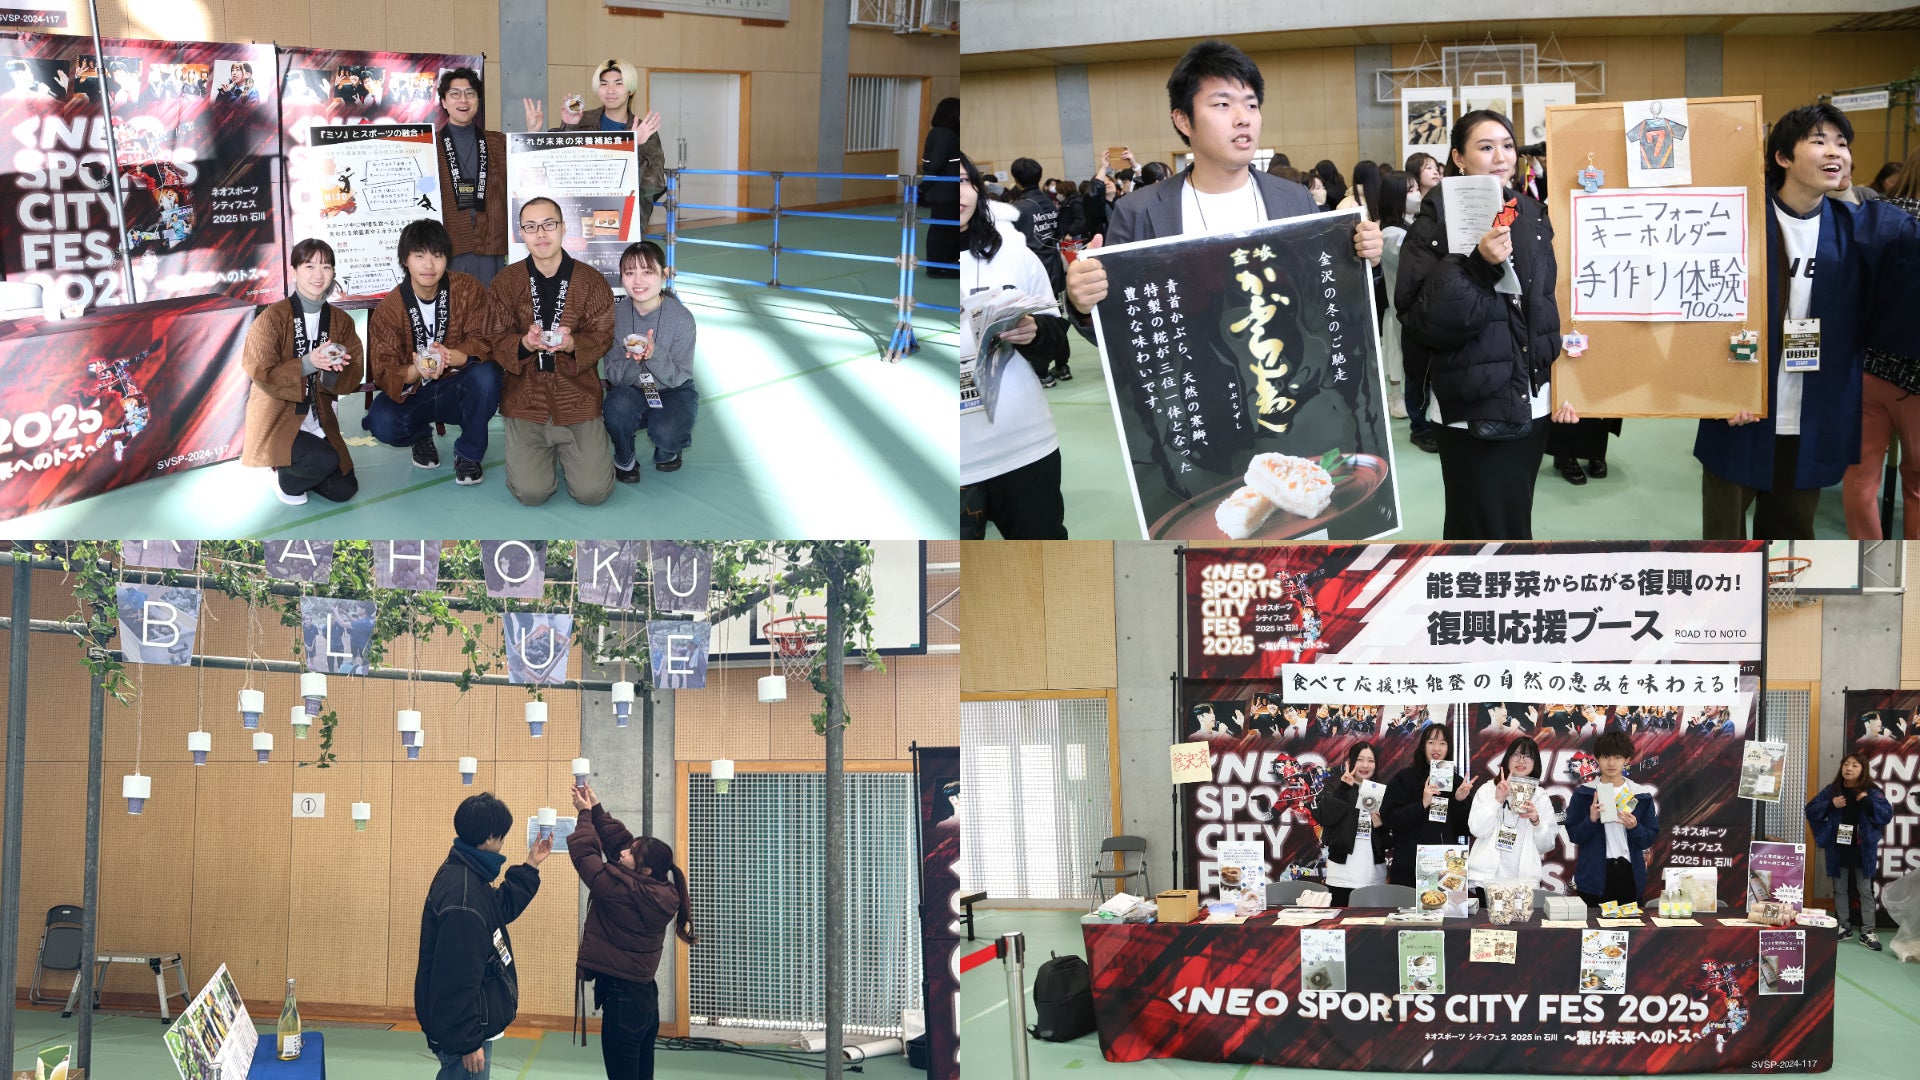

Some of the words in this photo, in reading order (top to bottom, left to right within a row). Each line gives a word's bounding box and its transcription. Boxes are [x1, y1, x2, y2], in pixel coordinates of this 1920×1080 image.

[1645, 129, 1666, 158] 7
[211, 186, 260, 198] ネオスポーツ
[18, 191, 129, 231] CITY
[212, 199, 257, 210] シティフェス
[1584, 202, 1731, 223] ユニフォーム
[213, 213, 238, 224] 2025
[239, 213, 248, 223] in
[249, 211, 266, 222] 石川
[1591, 219, 1728, 249] キーホルダー
[22, 232, 113, 271] FES
[1576, 256, 1746, 304] 手作り体験
[1318, 251, 1348, 384] 金沢の冬のご馳走
[1123, 287, 1163, 417] 豊かな味わいです。
[1143, 282, 1193, 474] 特製の糀が三位一体となった
[157, 444, 230, 470] SVSP-2024-117
[1201, 579, 1283, 599] SPORTS
[1426, 567, 1742, 600] 能登野菜から広がる復興の力！
[1201, 599, 1250, 618] CITY
[1255, 603, 1293, 612] ネオスポーツ
[1255, 613, 1291, 622] シティフェス
[1202, 617, 1241, 636] FES
[1255, 624, 1276, 632] 2025
[1276, 624, 1284, 632] in
[1285, 623, 1299, 632] 石川
[1426, 606, 1665, 647] 復興応援ブース
[1674, 629, 1700, 639] ROAD
[1705, 629, 1717, 639] TO
[1719, 629, 1748, 639] NOTO
[1203, 635, 1256, 656] 2025
[1671, 825, 1728, 838] ネオスポーツ
[1671, 839, 1723, 853] シティフェス
[1670, 855, 1700, 867] 2025
[1702, 855, 1712, 867] in
[1714, 857, 1733, 868] 石川
[1298, 992, 1435, 1022] SPORTS
[1444, 993, 1530, 1023] CITY
[1538, 993, 1605, 1024] FES
[1618, 993, 1709, 1024] 2025
[1424, 1032, 1466, 1042] ネオスポーツ
[1468, 1033, 1508, 1042] シティフェス
[1510, 1033, 1534, 1042] 2025
[1534, 1033, 1542, 1042] in
[1543, 1033, 1558, 1042] 石川
[1751, 1059, 1818, 1069] SVSP-2024-117
